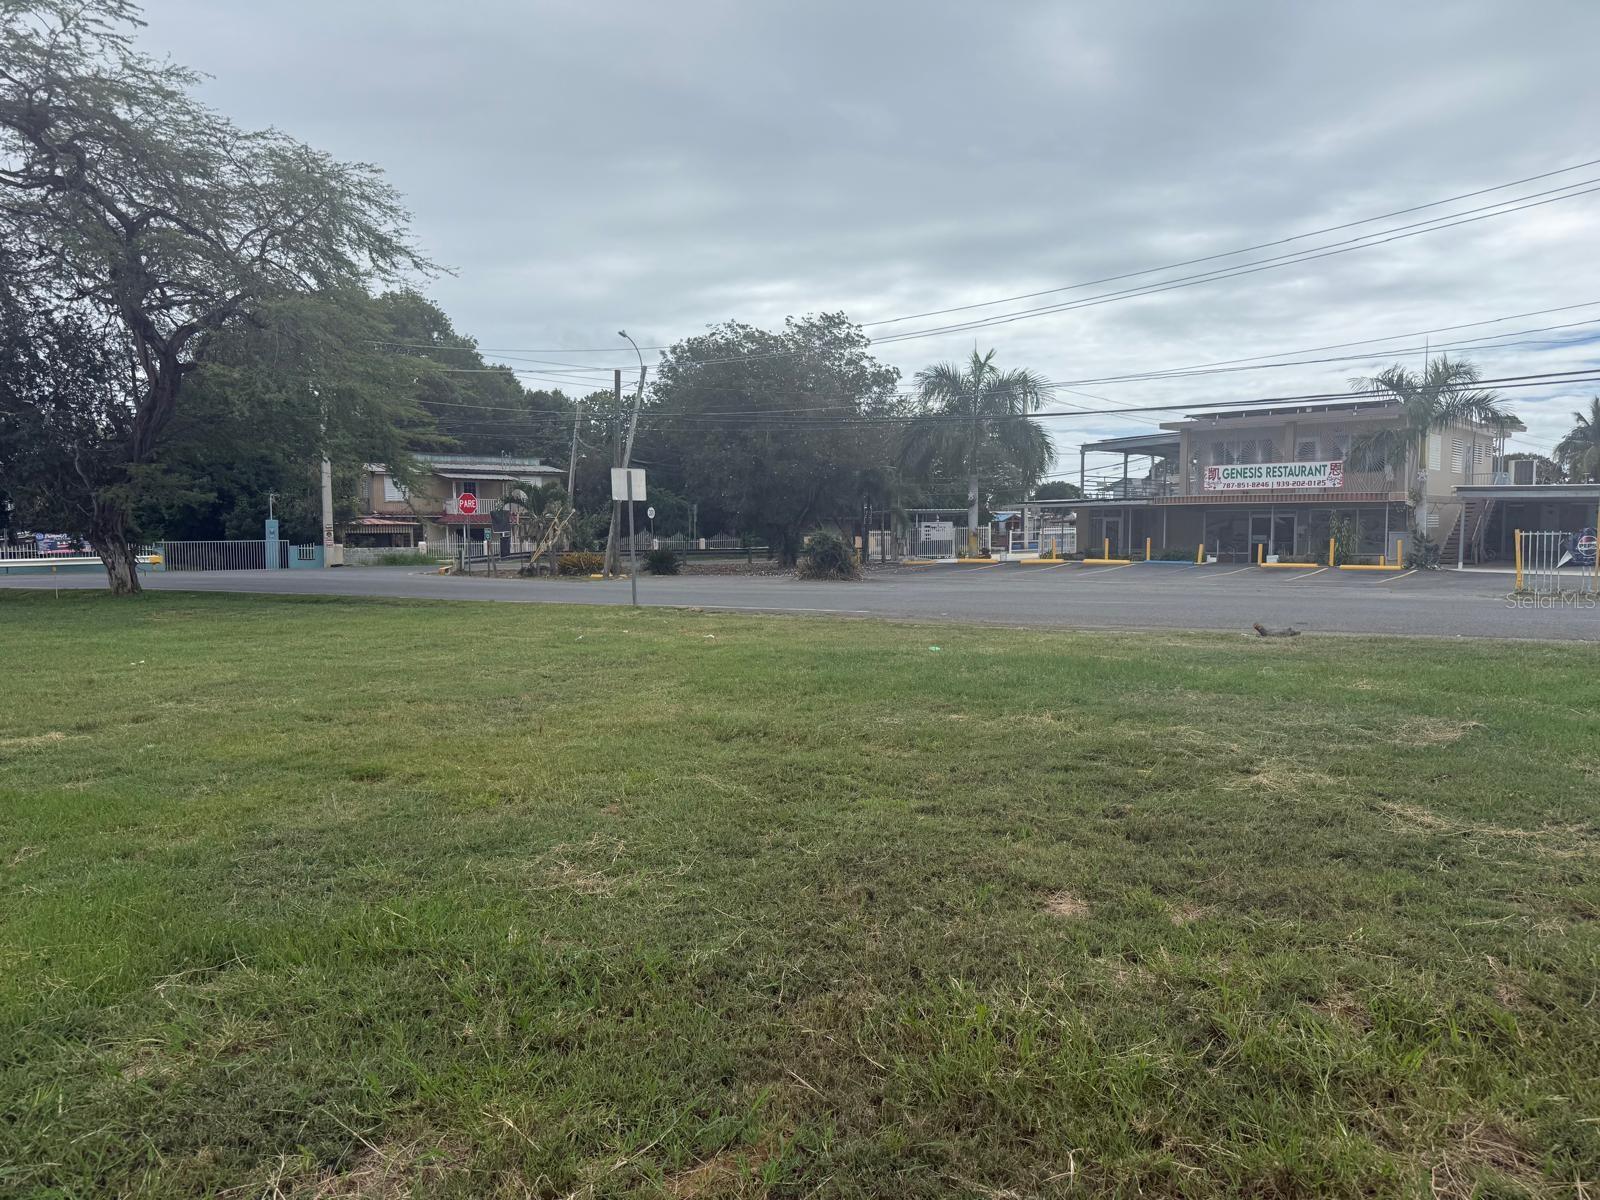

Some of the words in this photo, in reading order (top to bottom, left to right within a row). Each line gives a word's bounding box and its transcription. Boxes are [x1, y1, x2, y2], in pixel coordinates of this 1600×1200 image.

[1222, 466, 1263, 480] GENESIS
[1265, 464, 1328, 478] RESTAURANT
[459, 499, 476, 509] PARE
